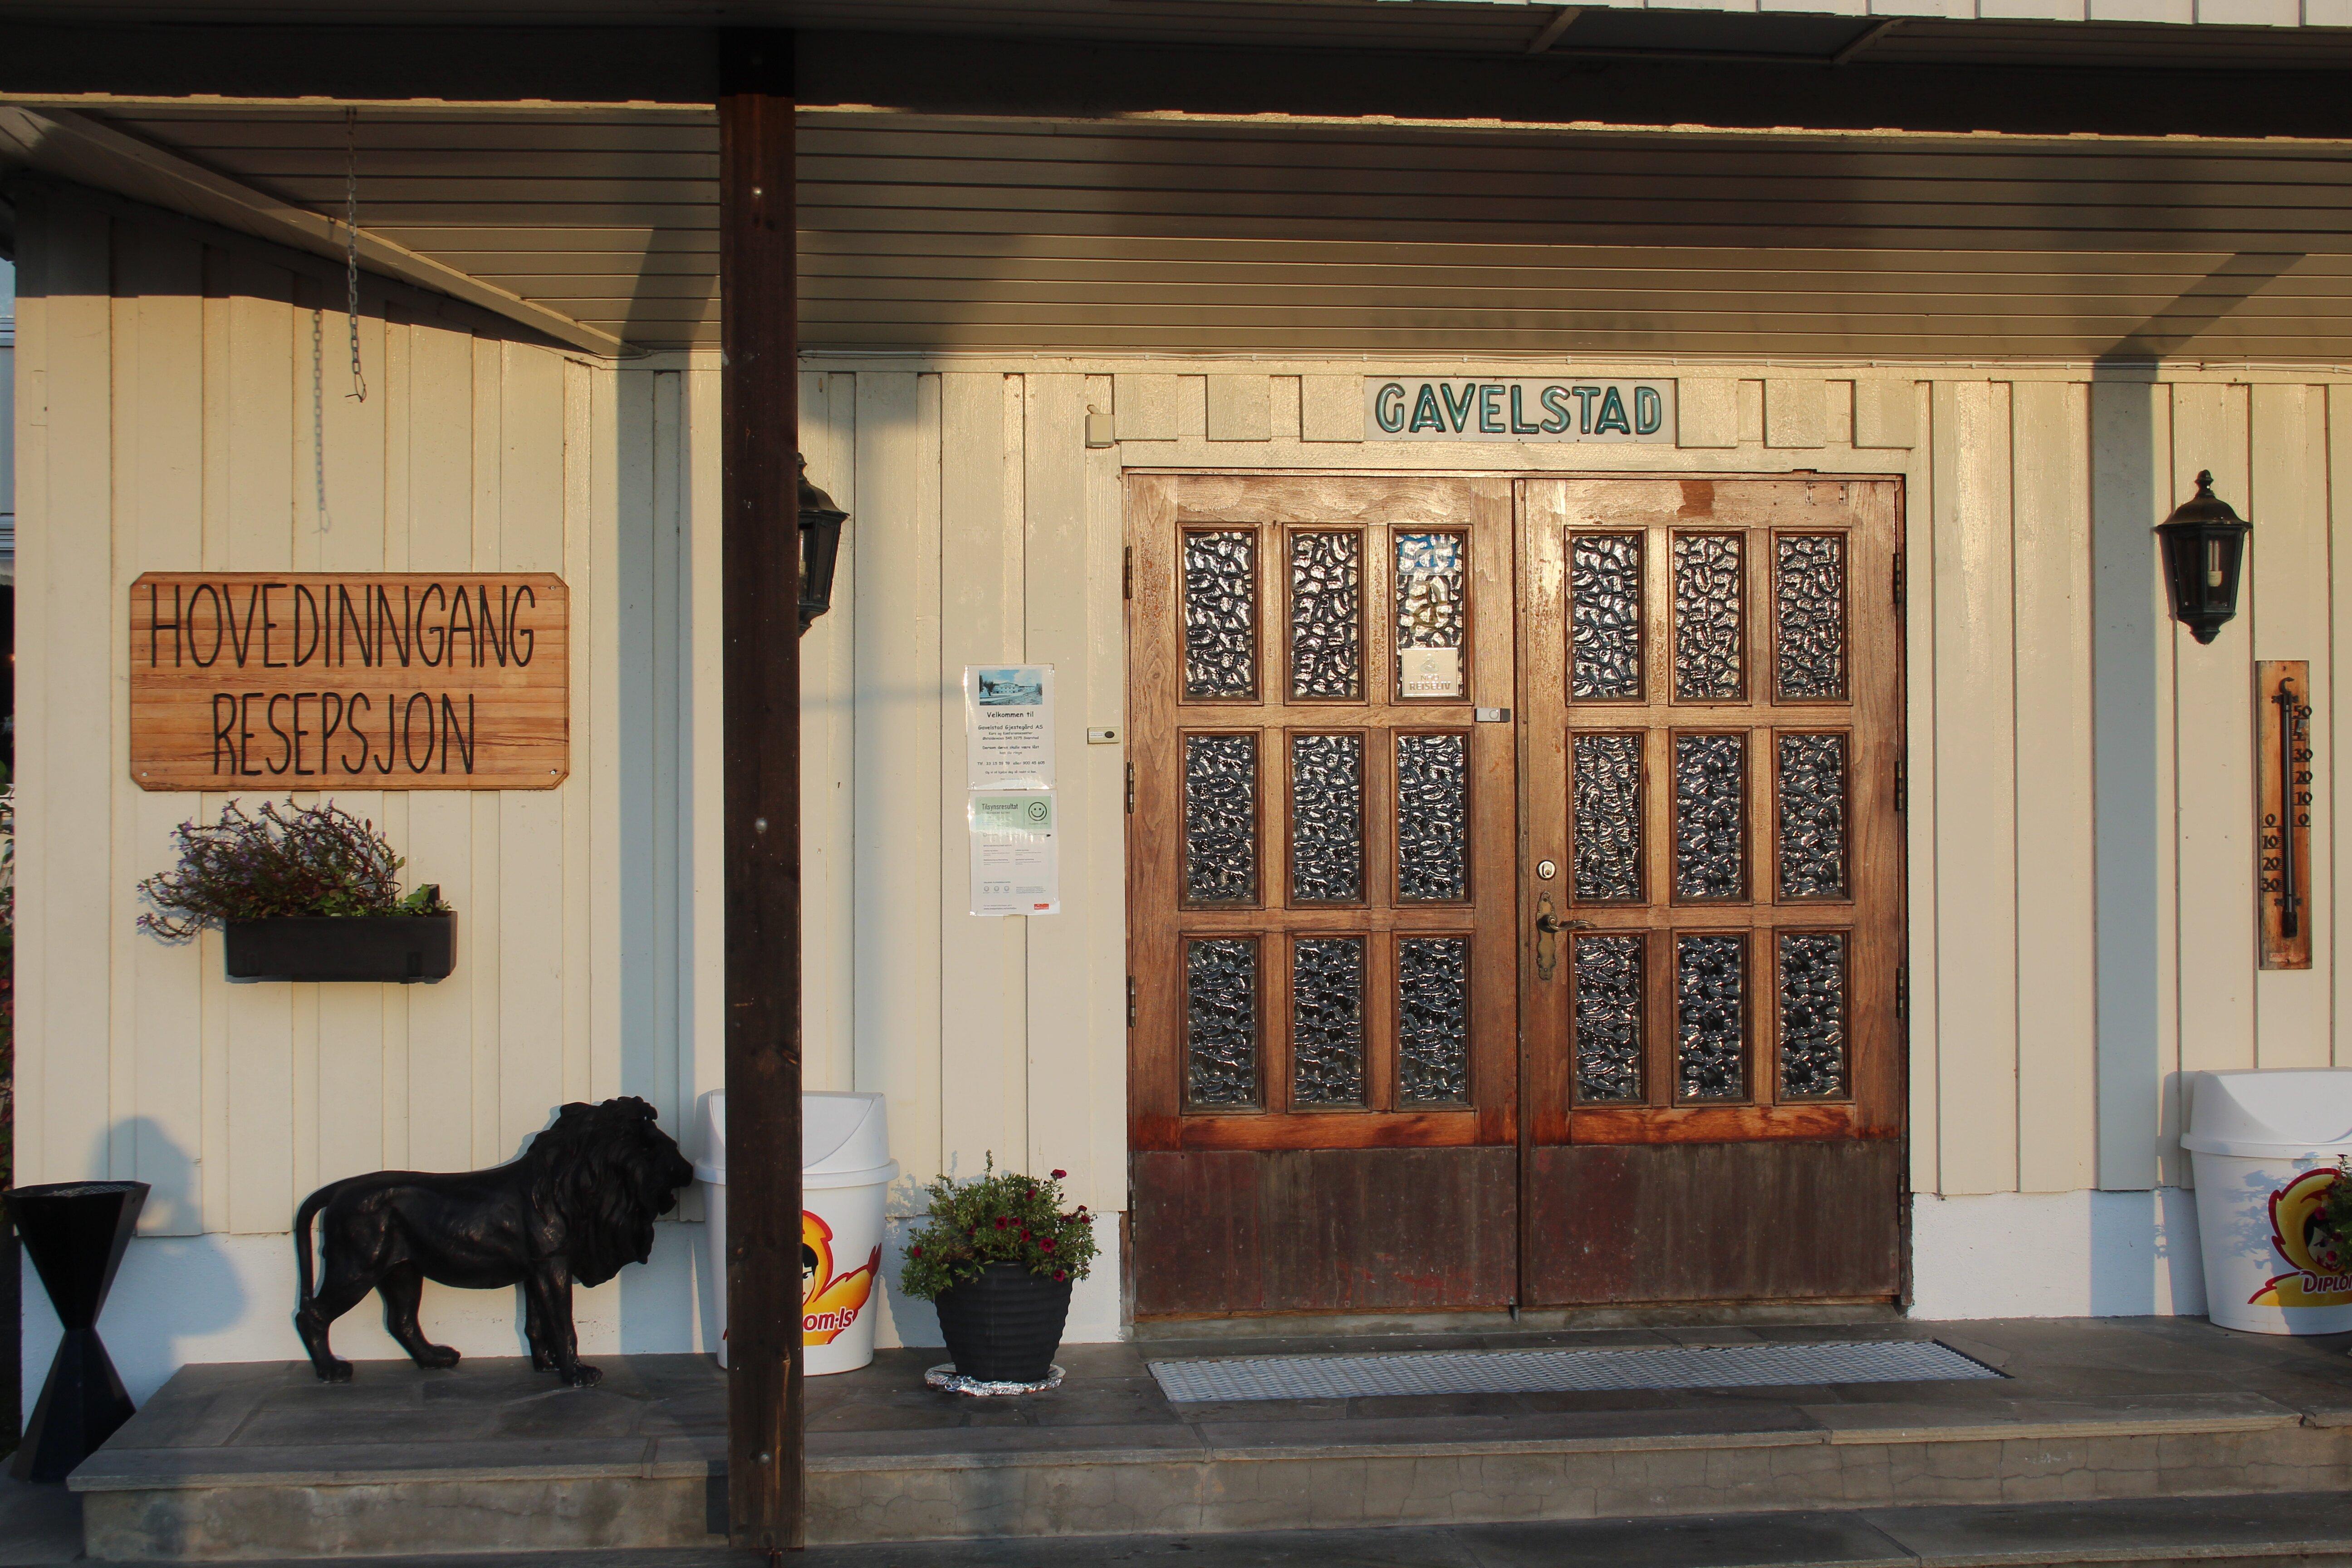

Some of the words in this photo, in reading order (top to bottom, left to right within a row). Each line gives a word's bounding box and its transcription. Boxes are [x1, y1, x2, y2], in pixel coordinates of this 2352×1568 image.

[1375, 383, 1662, 435] GAVELSTAD
[151, 583, 535, 668] HOVEDINNGANG
[1409, 681, 1451, 690] REISELIV
[2293, 705, 2312, 718] 50
[213, 692, 475, 775] RESEPSJON
[2295, 748, 2313, 761] 30
[2296, 771, 2313, 783] 20
[2296, 792, 2312, 804] 10
[2265, 813, 2276, 826] 0
[2298, 813, 2309, 826] 0
[2262, 835, 2279, 848] 10
[2263, 857, 2280, 870] 20
[2260, 878, 2280, 891] 30
[2300, 1270, 2352, 1293] DIPLO
